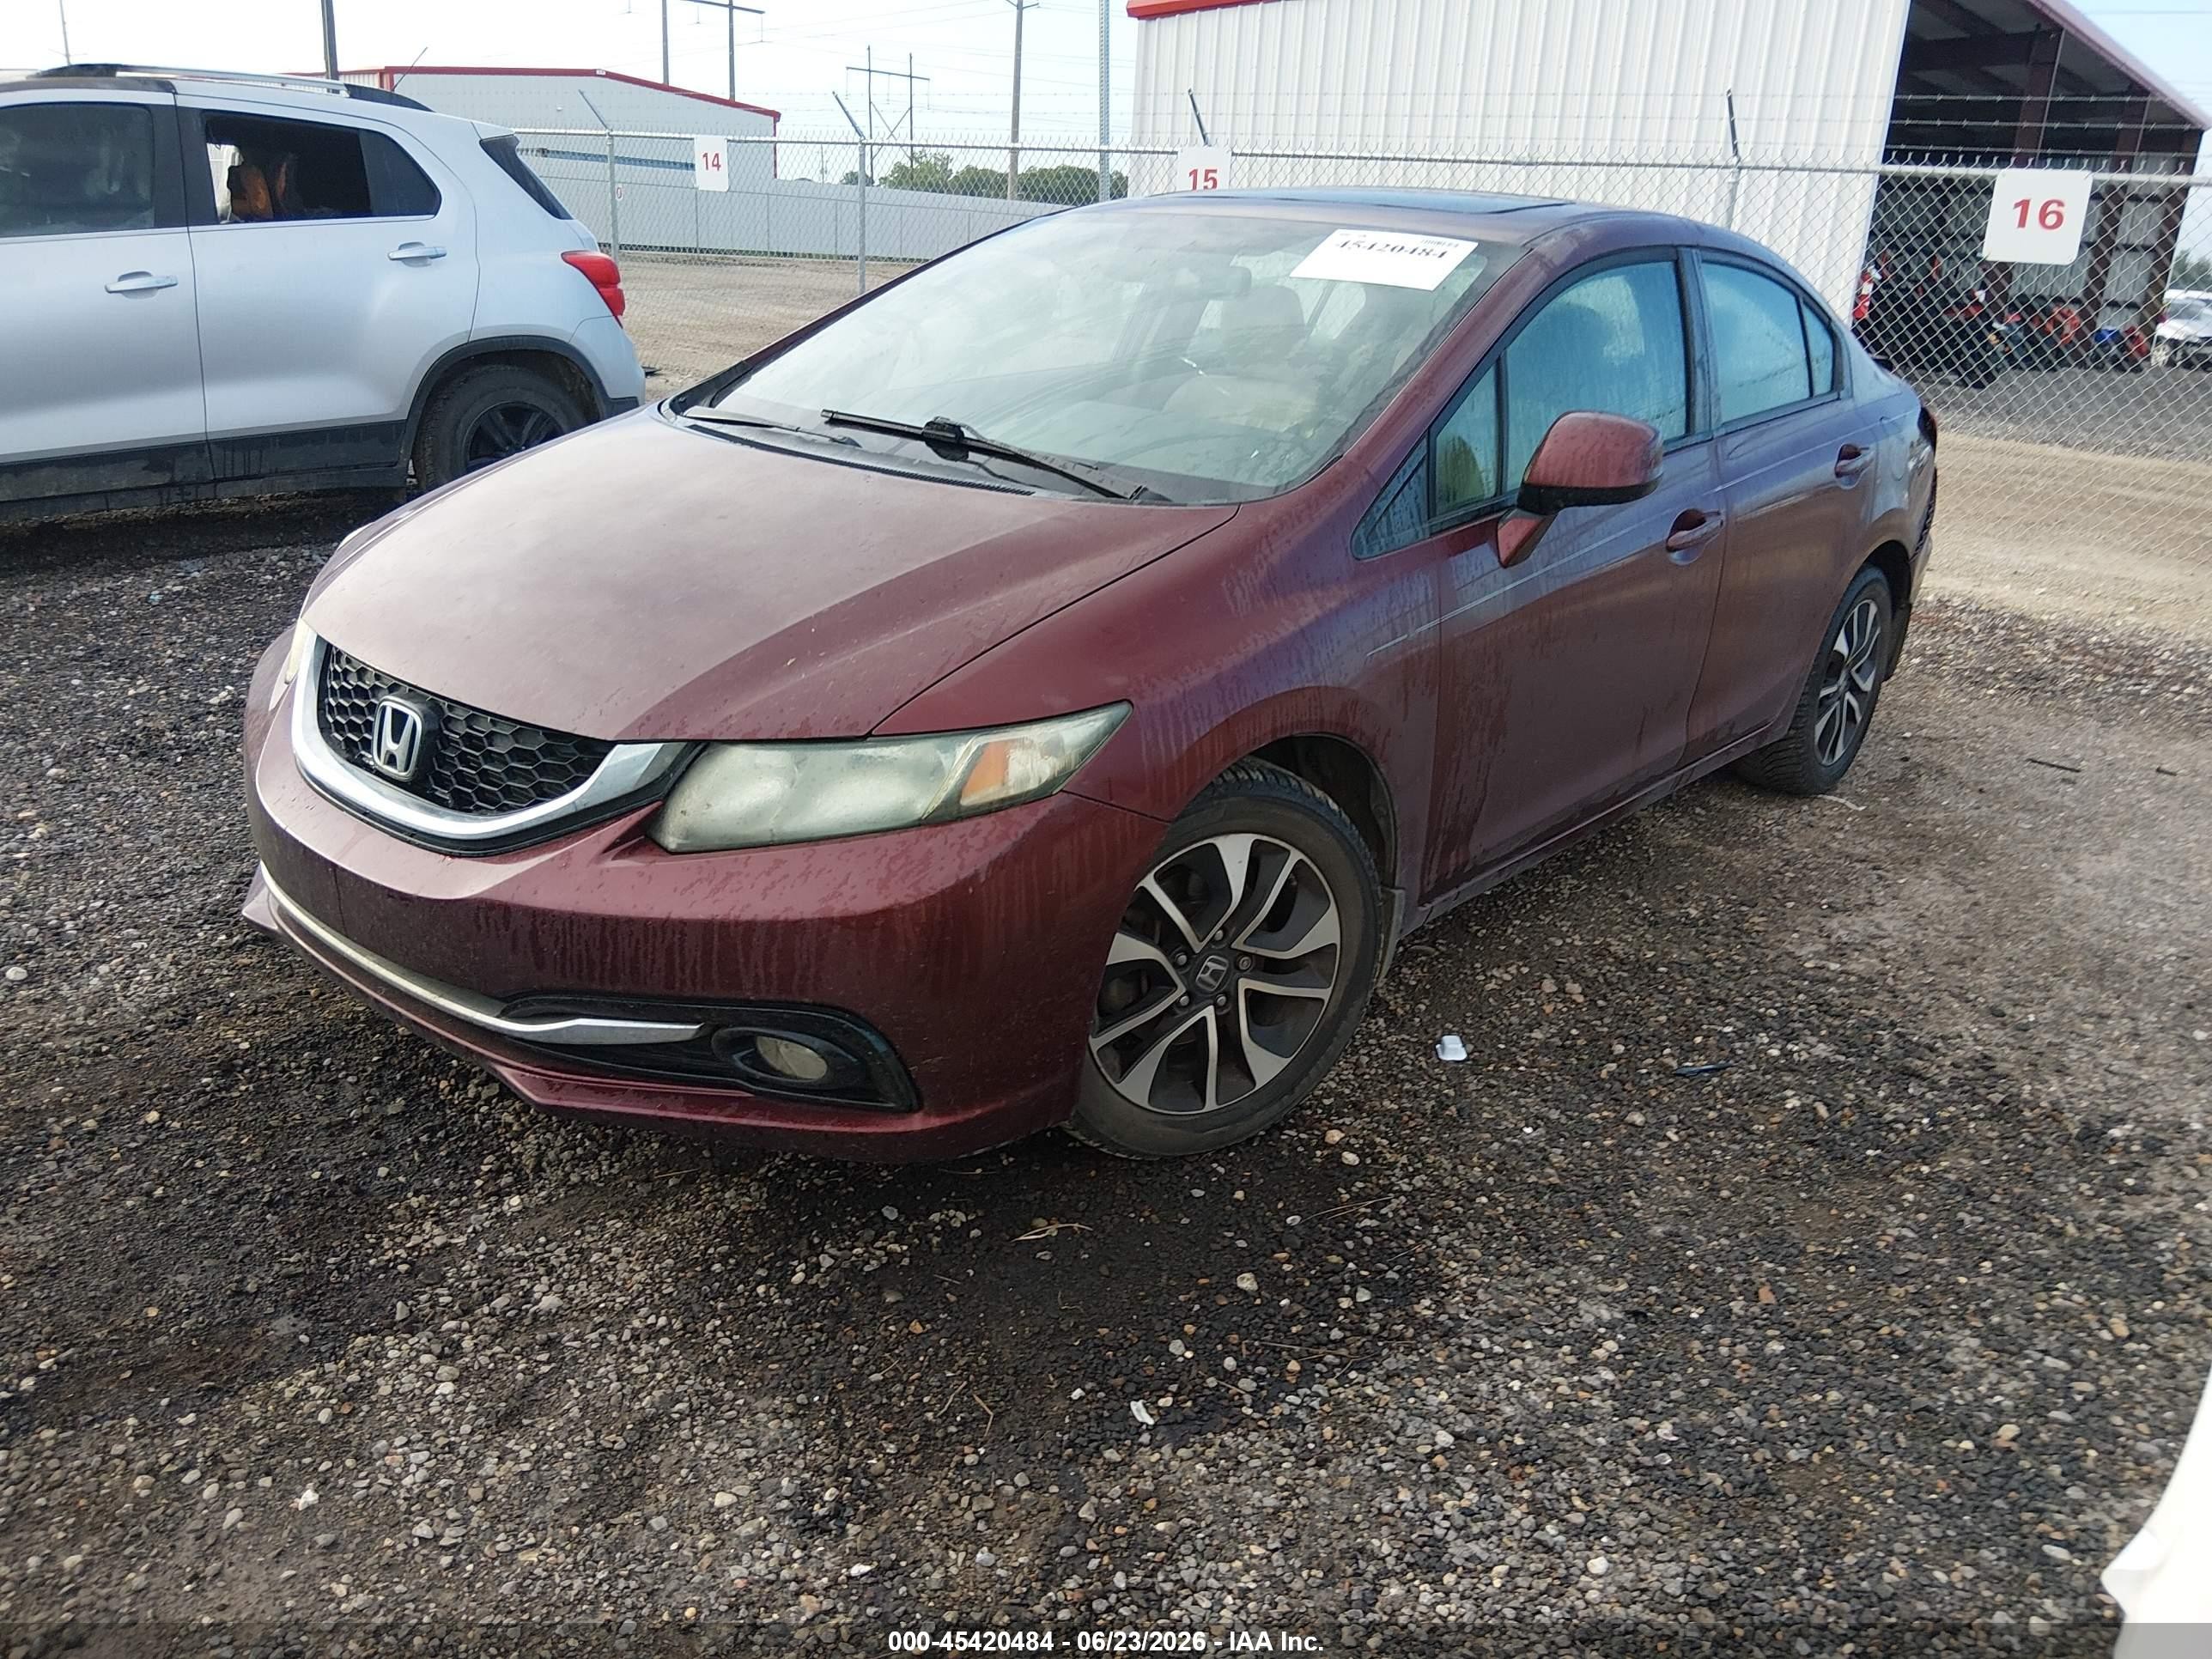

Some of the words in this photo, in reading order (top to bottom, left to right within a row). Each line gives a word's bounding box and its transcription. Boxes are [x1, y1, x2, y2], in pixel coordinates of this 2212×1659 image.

[702, 152, 721, 172] 14
[1188, 168, 1218, 191] 15
[2013, 198, 2065, 230] 16
[1336, 240, 1448, 258] 45420484
